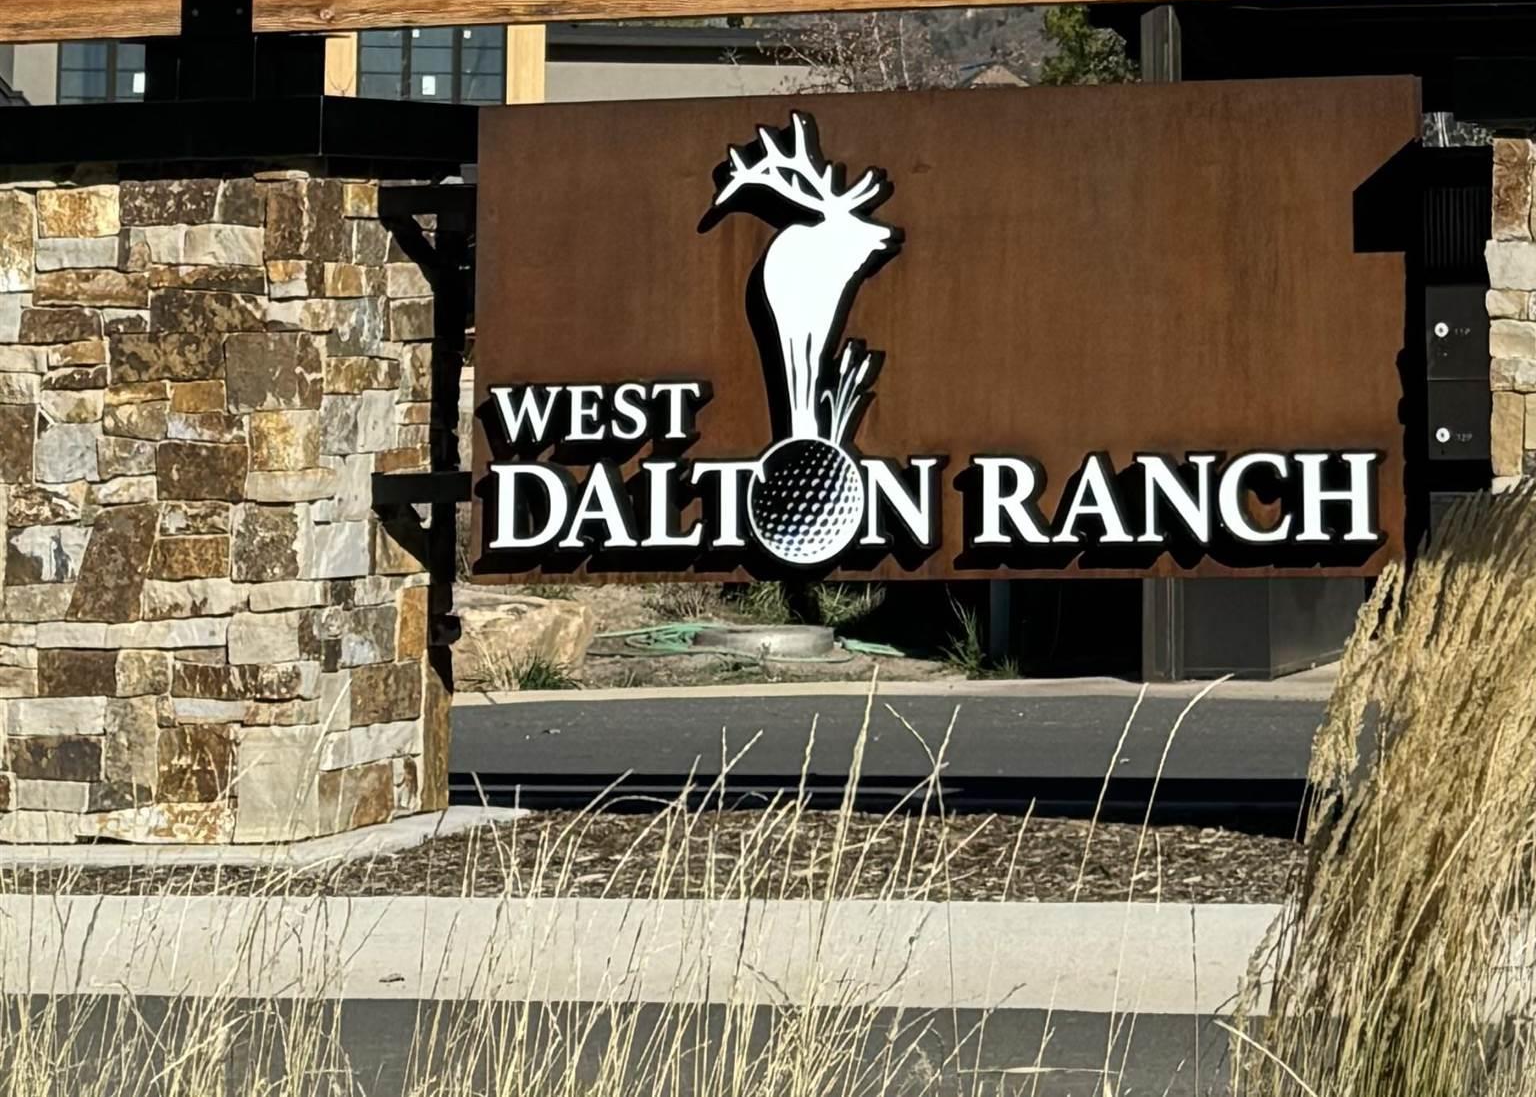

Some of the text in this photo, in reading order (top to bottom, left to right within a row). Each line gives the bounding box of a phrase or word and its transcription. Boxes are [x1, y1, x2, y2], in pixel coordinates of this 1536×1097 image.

[489, 382, 701, 442] WEST
[488, 436, 1378, 564] DALTON RANCH
